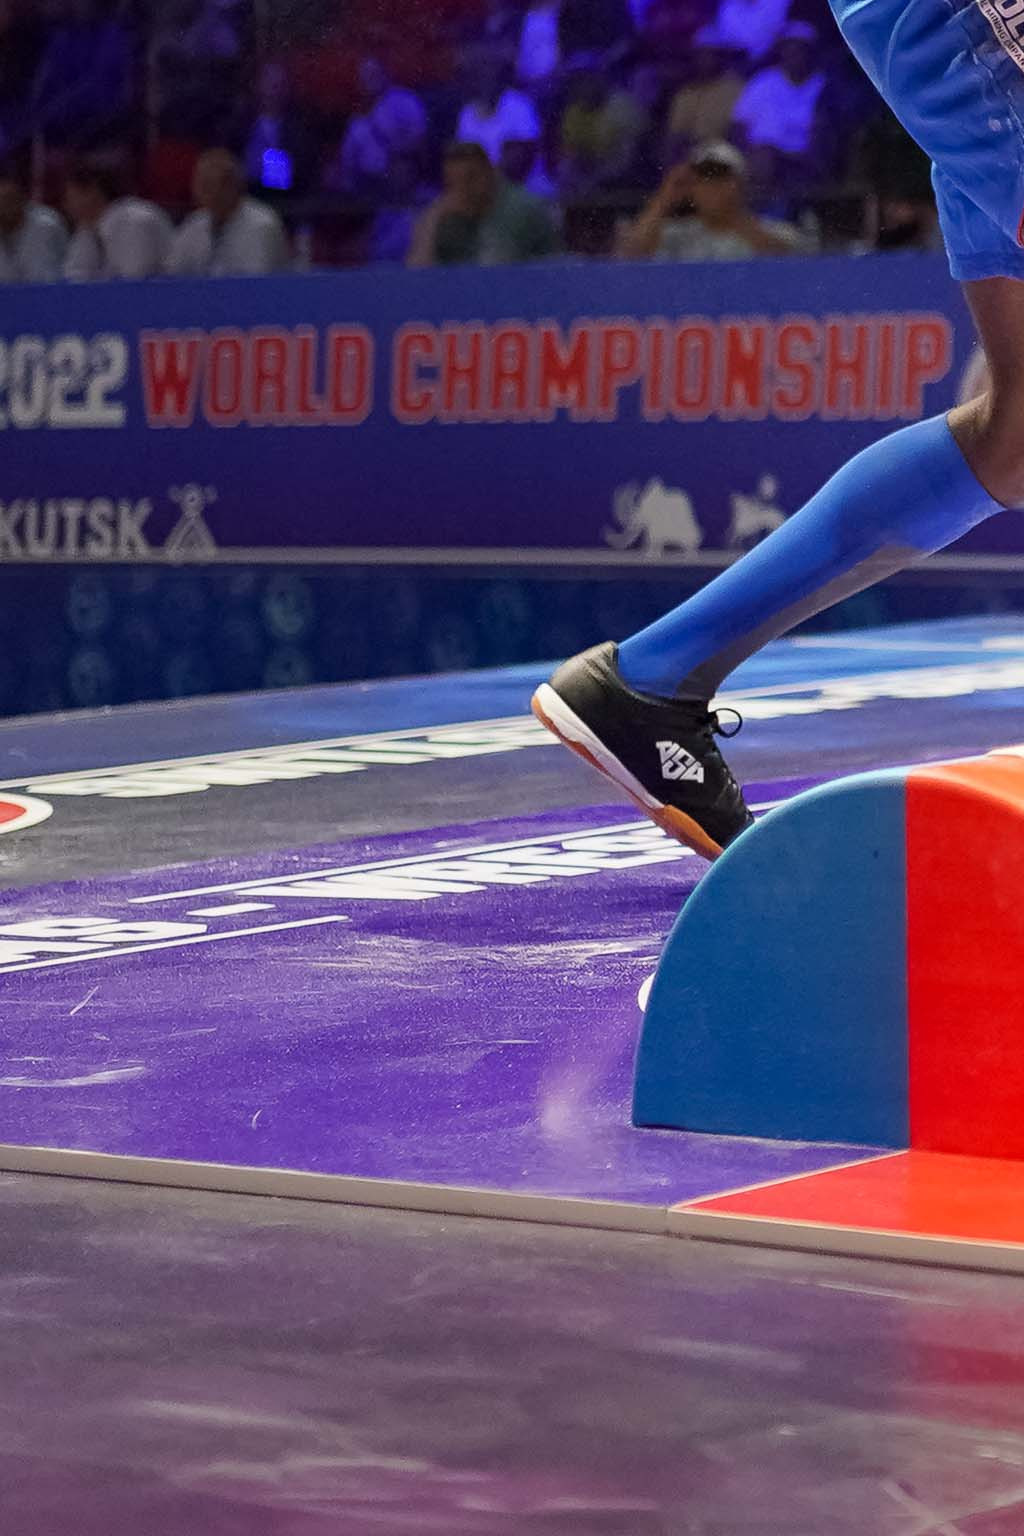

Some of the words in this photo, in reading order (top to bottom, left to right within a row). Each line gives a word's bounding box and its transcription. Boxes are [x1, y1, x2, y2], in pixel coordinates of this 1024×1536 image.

[0, 332, 129, 429] 022
[140, 327, 373, 428] WORLD
[392, 314, 953, 424] CHAMPIONSHIP
